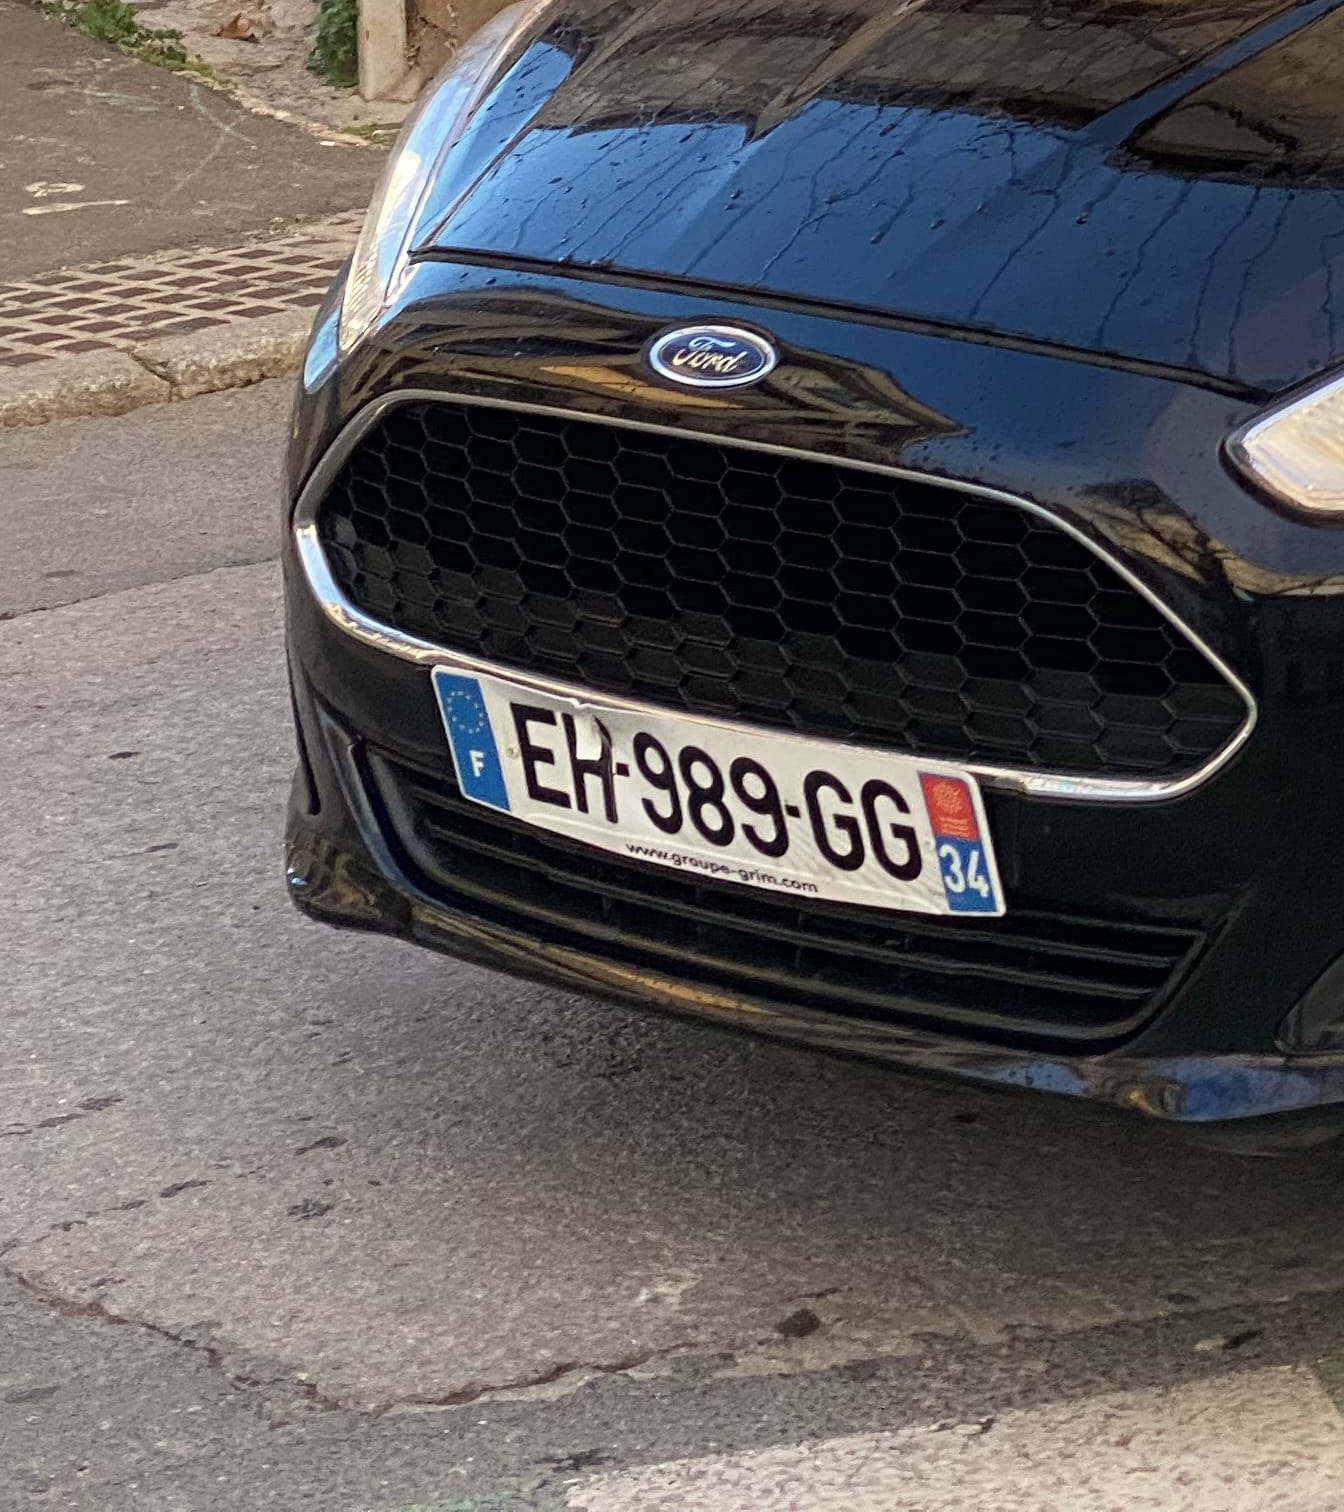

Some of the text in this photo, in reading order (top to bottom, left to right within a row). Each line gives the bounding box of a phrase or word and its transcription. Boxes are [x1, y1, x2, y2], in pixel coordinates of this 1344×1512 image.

[672, 336, 747, 373] Ford
[469, 750, 485, 778] F
[510, 702, 922, 882] EH-989-GG
[626, 843, 819, 893] www.groupe-grim.com
[939, 844, 989, 898] 34
